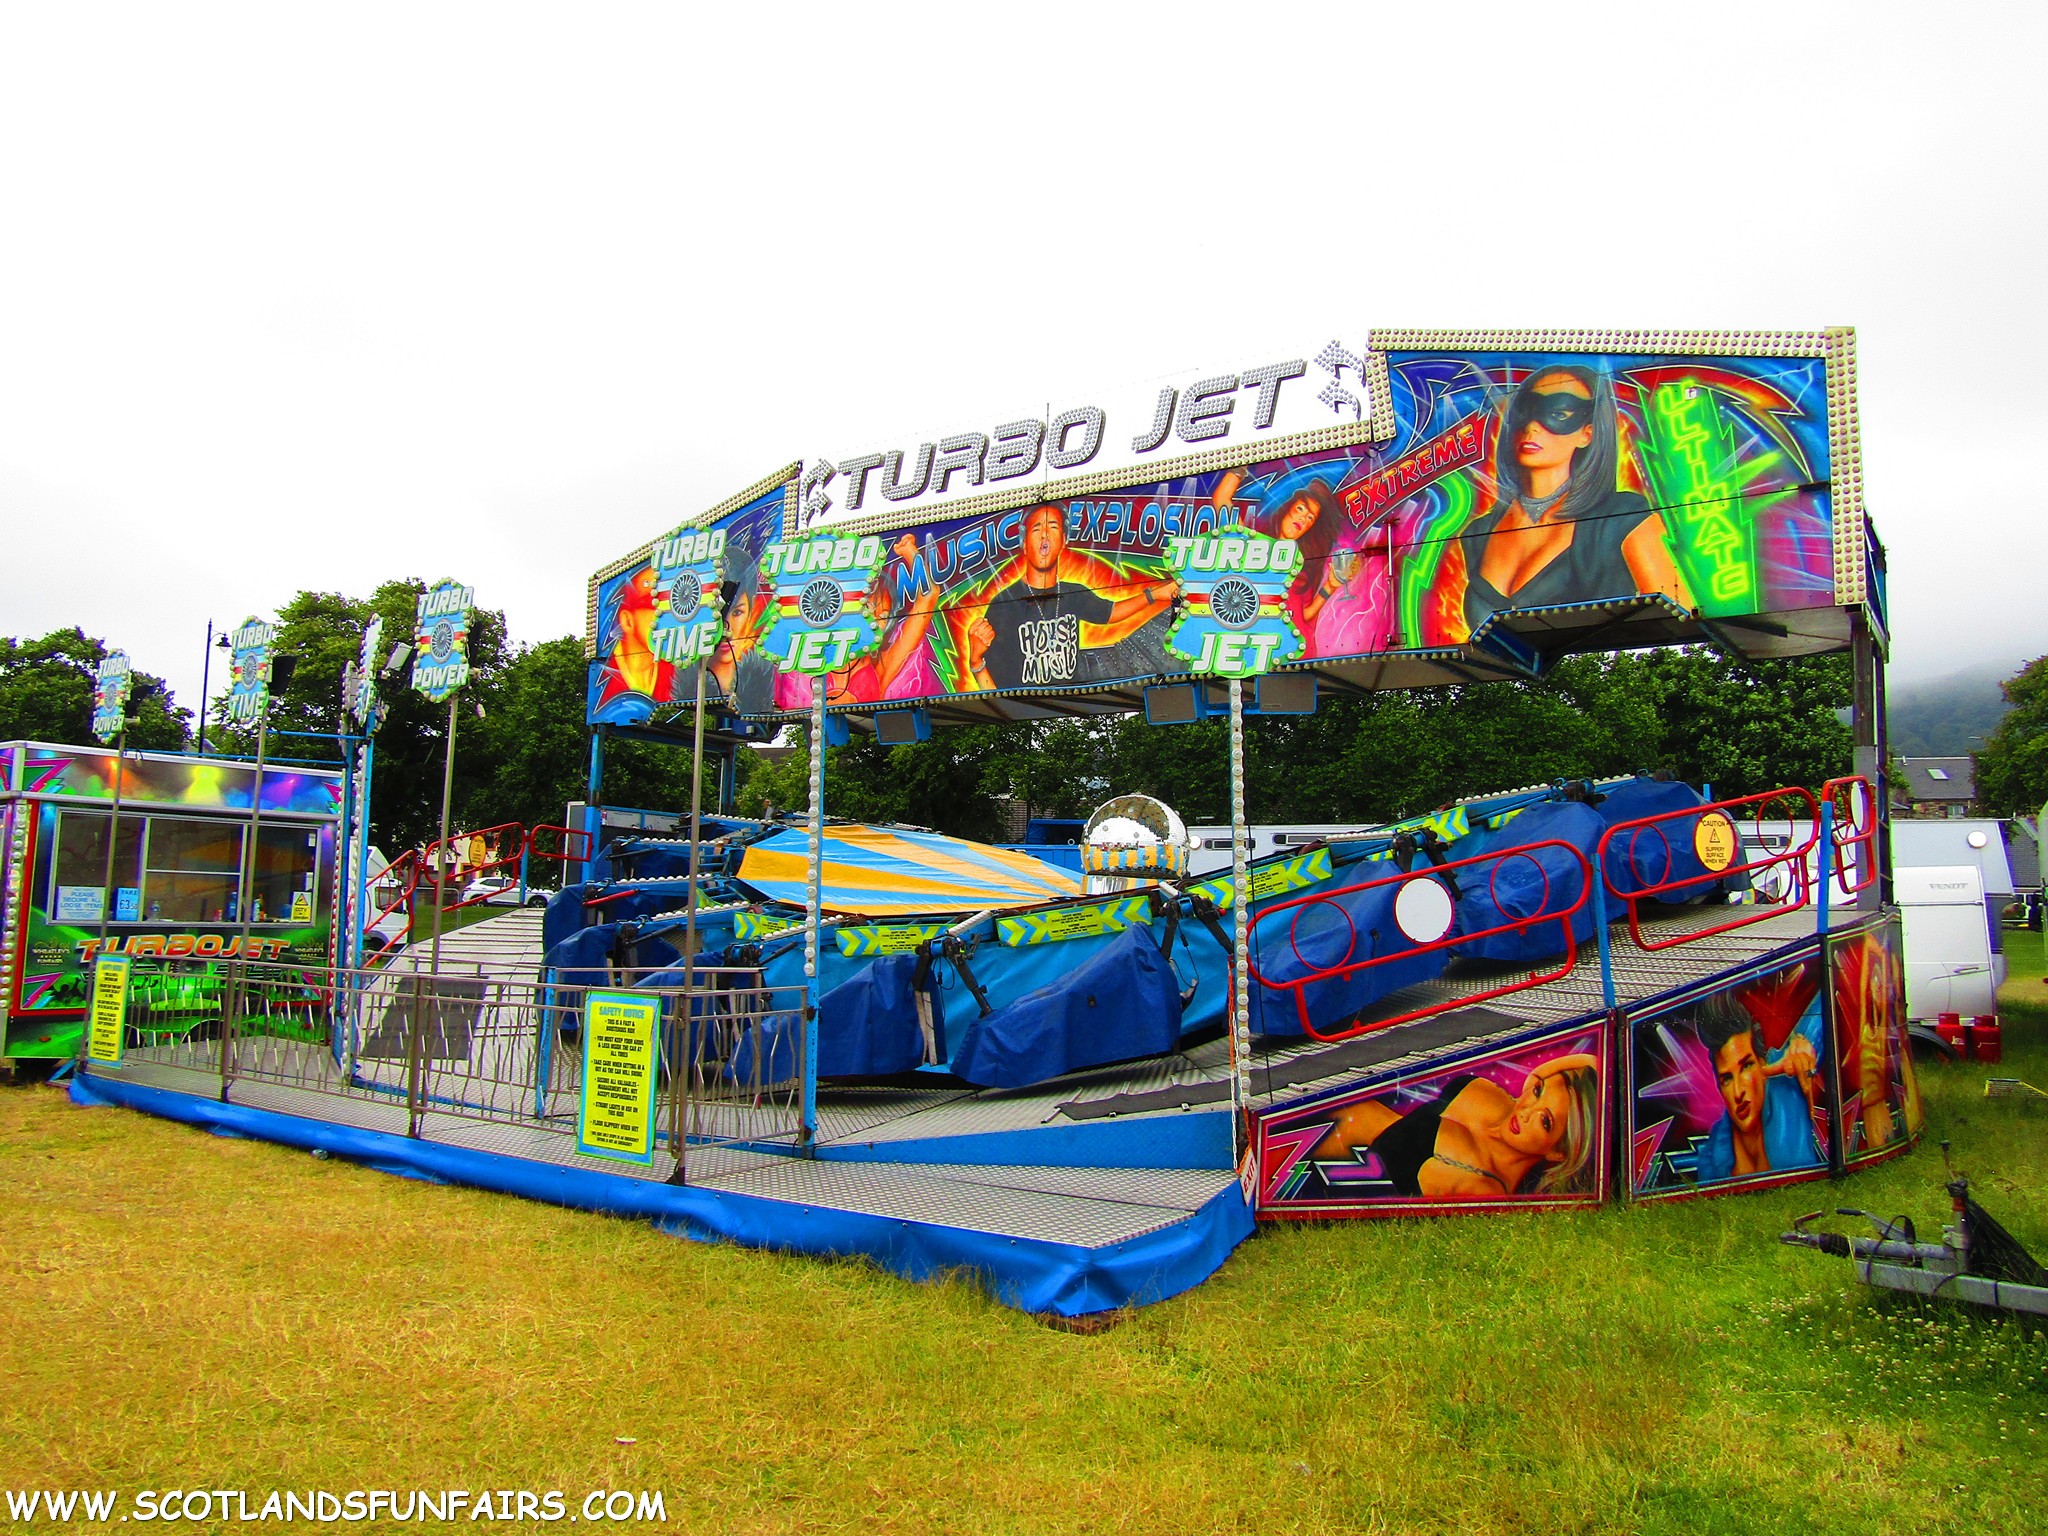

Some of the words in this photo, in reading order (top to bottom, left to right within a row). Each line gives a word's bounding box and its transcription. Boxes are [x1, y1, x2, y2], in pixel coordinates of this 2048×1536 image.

[836, 405, 1105, 509] TURBO
[1132, 358, 1307, 452] JET
[1348, 423, 1478, 529] EXTREME
[1656, 380, 1750, 601] ULTIMATE
[652, 529, 727, 570] TURBO
[766, 536, 882, 576] TURBO
[896, 508, 1023, 605] MUSIC
[1171, 537, 1298, 573] TURBO
[418, 586, 474, 619] TURBO
[232, 623, 274, 650] TURBO
[652, 621, 719, 662] TIME
[779, 630, 860, 672] JET
[1018, 614, 1077, 655] HOUSE
[1191, 633, 1277, 673] JET
[100, 656, 131, 679] TURBO
[411, 664, 470, 690] POWER
[93, 715, 124, 734] POWER
[229, 691, 267, 721] TIME
[75, 934, 291, 963] TURBOJET
[599, 1006, 621, 1016] SAFETY
[623, 1008, 645, 1019] NOTICE
[1243, 1157, 1255, 1193] EXIT
